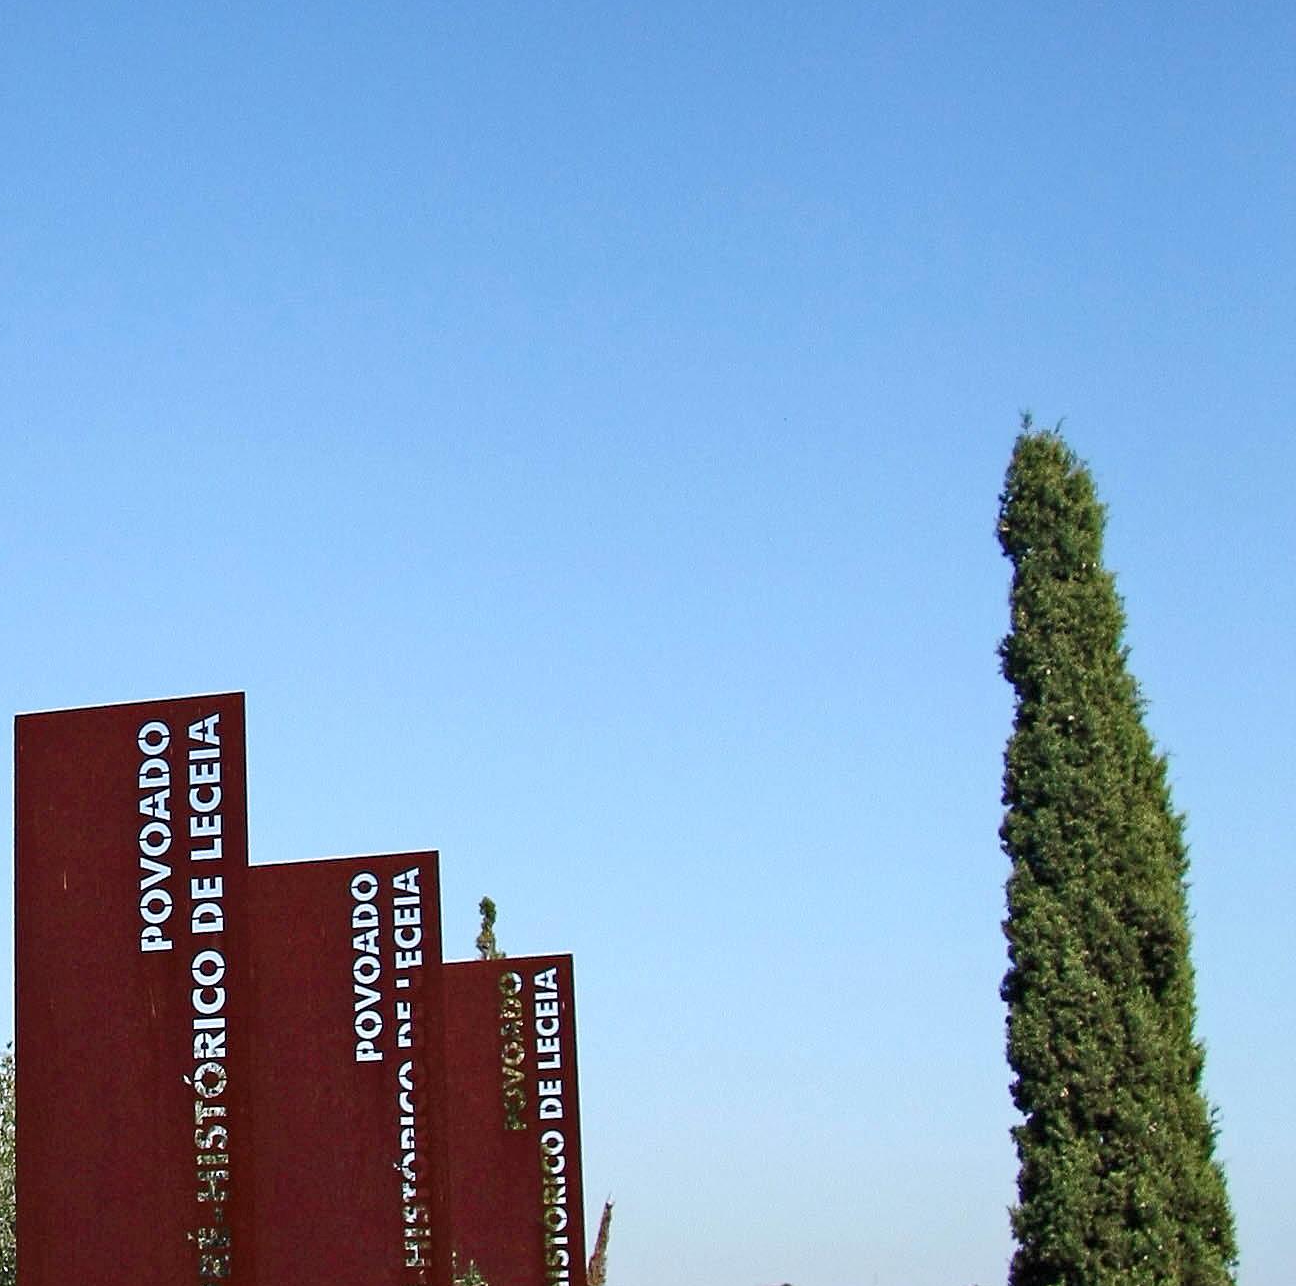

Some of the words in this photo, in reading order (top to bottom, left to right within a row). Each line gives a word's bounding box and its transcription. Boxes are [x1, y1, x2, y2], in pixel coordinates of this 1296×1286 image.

[138, 720, 174, 952] POVOADO
[188, 713, 223, 861] LECEIA
[190, 875, 224, 935] DE
[351, 871, 384, 1062] POVOADO
[534, 966, 562, 1070] LECEIA
[537, 1079, 564, 1120] DE
